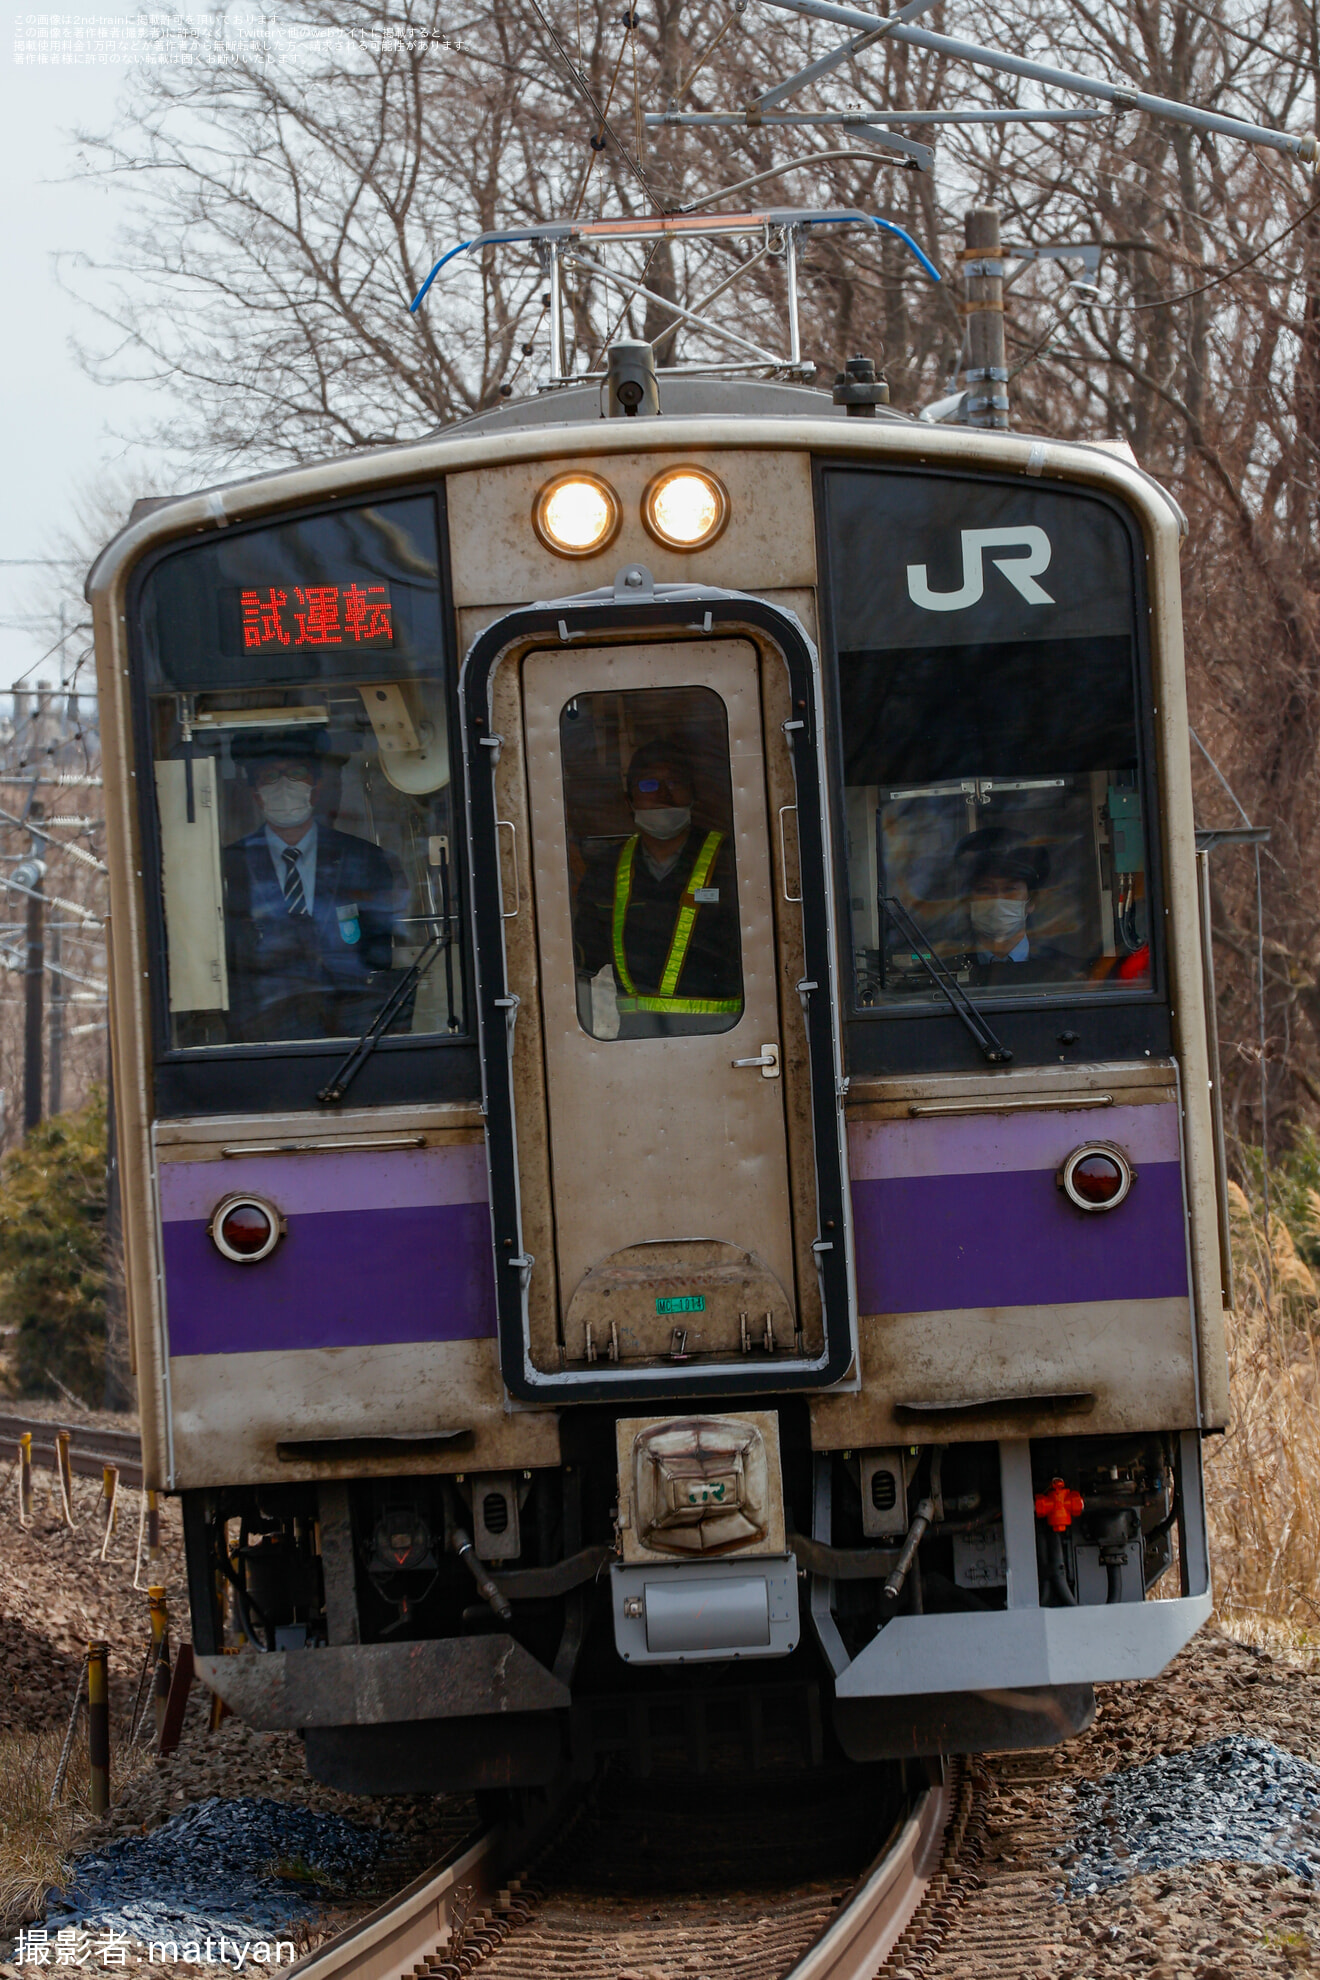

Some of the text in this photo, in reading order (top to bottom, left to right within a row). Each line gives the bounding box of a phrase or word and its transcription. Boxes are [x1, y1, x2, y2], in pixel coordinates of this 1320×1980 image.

[907, 525, 1056, 612] JR
[240, 583, 393, 647] 試運転
